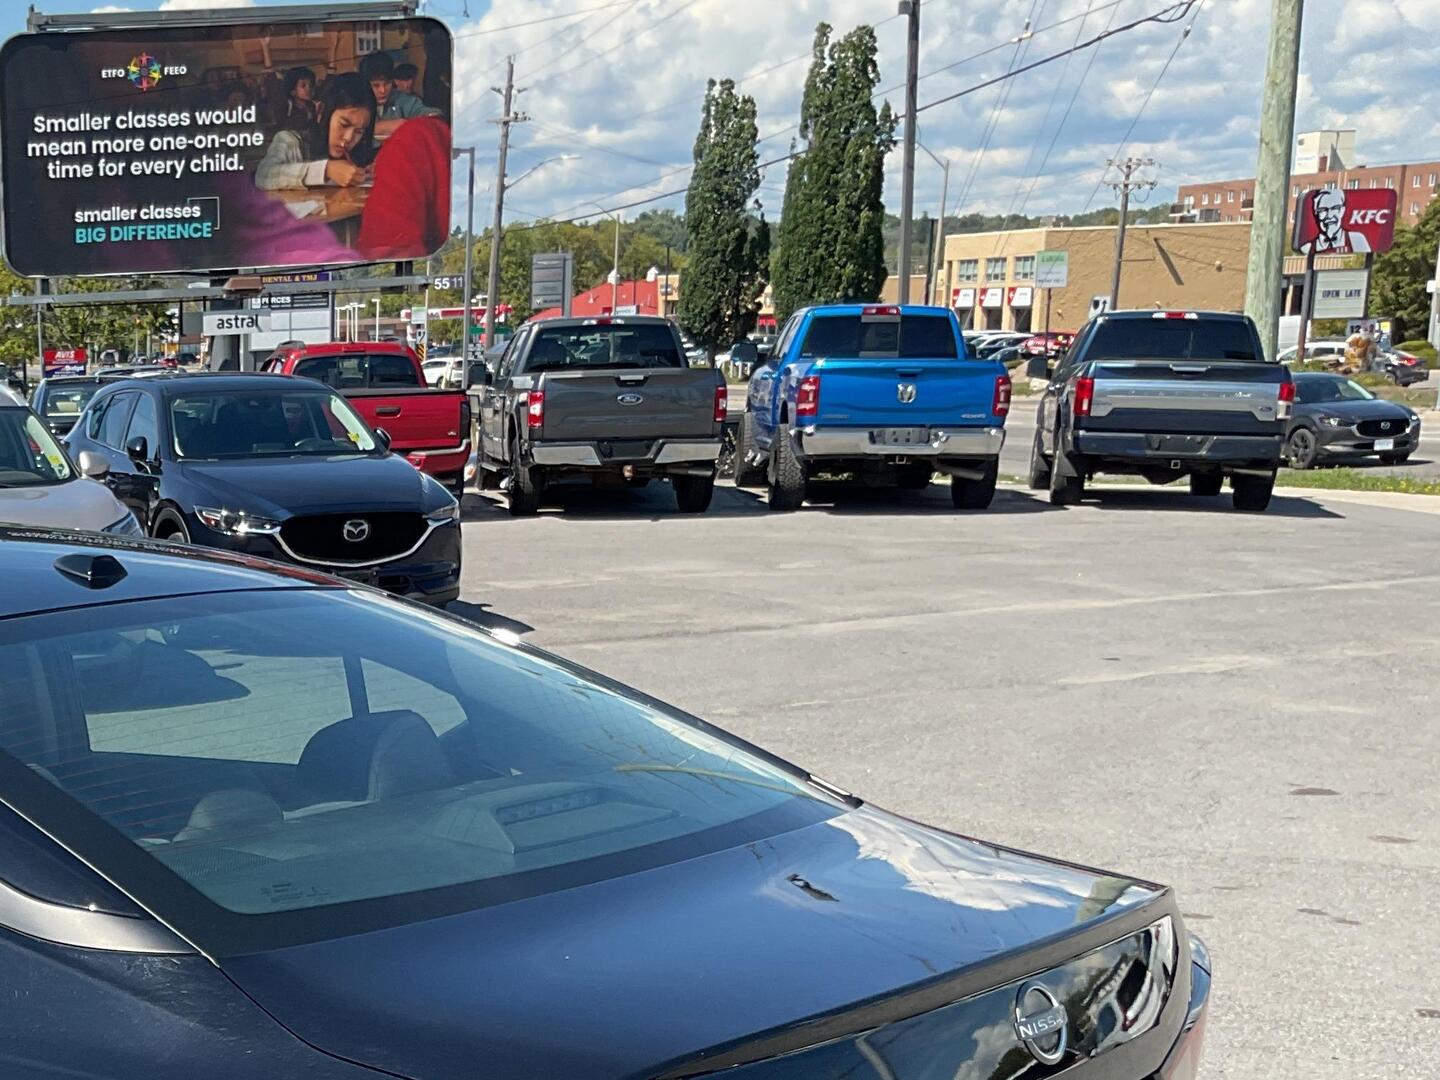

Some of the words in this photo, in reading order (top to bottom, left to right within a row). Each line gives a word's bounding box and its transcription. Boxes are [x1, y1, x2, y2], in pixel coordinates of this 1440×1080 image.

[101, 69, 125, 79] ETFO
[164, 66, 187, 76] FEEO
[33, 113, 111, 133] Smaller
[115, 111, 190, 130] classes
[195, 105, 256, 126] would
[27, 141, 86, 157] mean
[92, 137, 144, 154] more
[149, 131, 264, 151] one-on-one
[47, 159, 93, 179] time
[98, 159, 126, 177] for
[130, 159, 184, 179] every
[190, 153, 244, 173] child.
[74, 206, 137, 223] smaller
[139, 204, 201, 220] classes
[1349, 209, 1390, 225] KFC
[75, 227, 106, 243] BIG
[110, 222, 212, 242] DIFFERENCE
[434, 277, 450, 290] 55
[1322, 289, 1340, 298] OPEN
[1345, 288, 1362, 298] LATE
[216, 314, 259, 330] astral
[55, 350, 76, 359] AVIS
